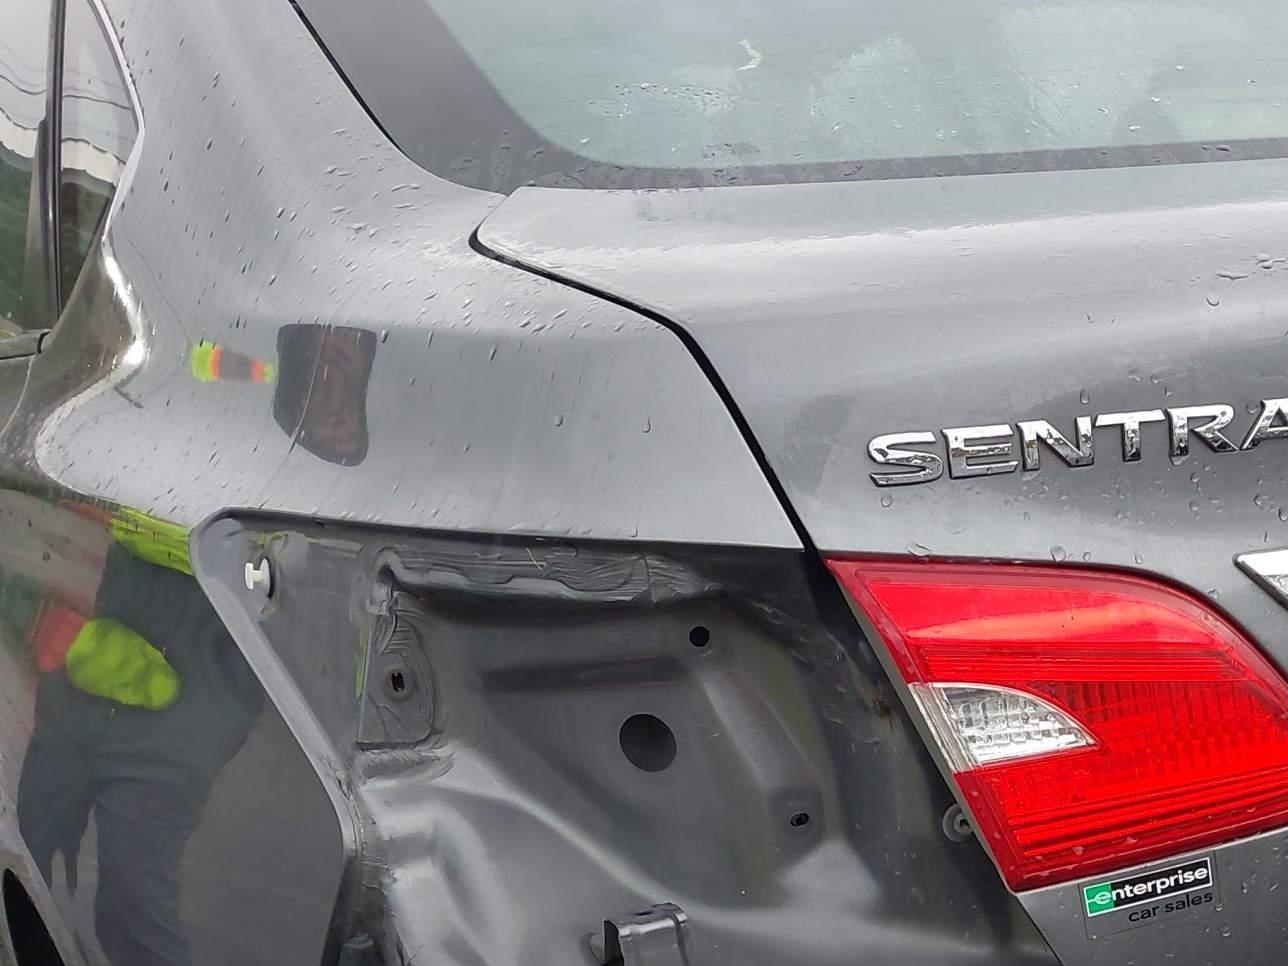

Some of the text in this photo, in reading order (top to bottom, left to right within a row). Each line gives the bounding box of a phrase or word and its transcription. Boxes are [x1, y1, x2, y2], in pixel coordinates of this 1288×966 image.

[1091, 866, 1208, 905] enterprise
[1128, 892, 1213, 922] car sales
